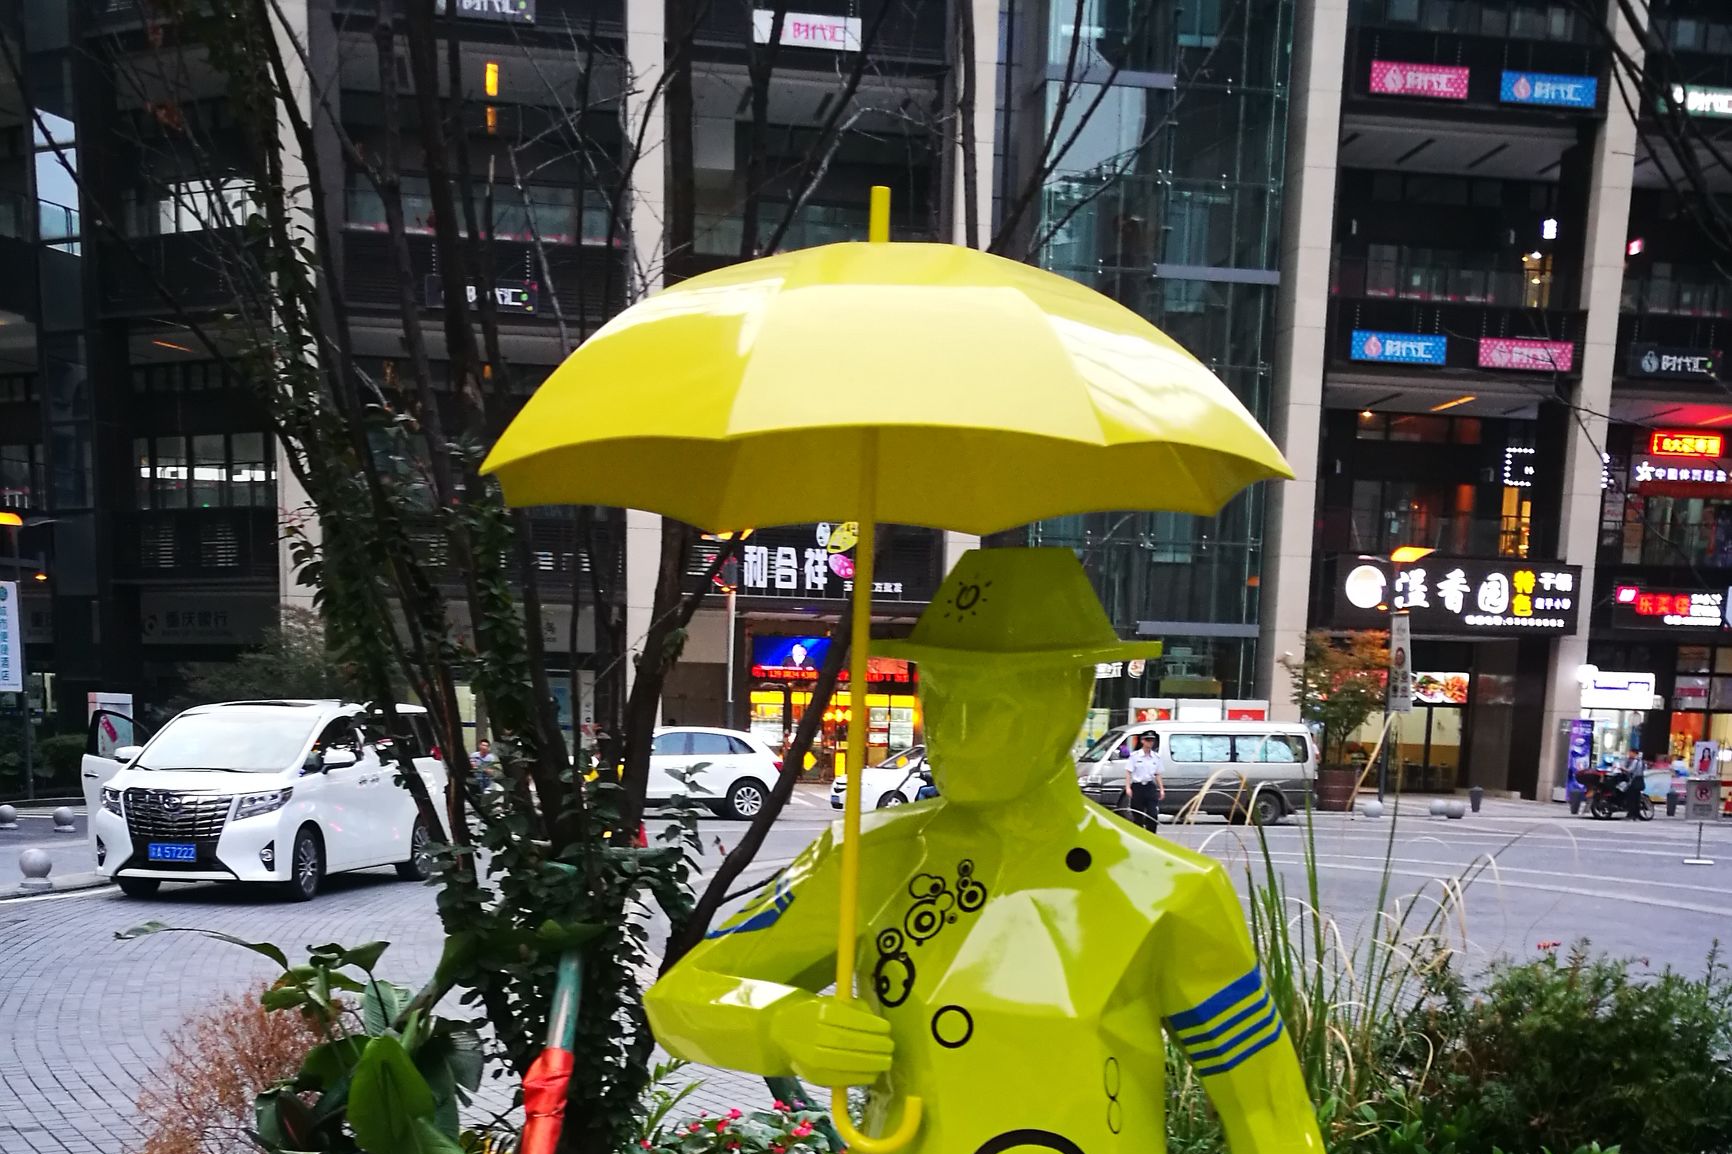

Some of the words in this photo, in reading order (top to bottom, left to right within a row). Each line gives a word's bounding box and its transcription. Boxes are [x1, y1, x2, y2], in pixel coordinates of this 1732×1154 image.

[793, 22, 846, 42] 时代汇
[1406, 71, 1457, 91] 时代汇
[1534, 81, 1584, 101] 时代汇
[1384, 339, 1433, 359] 时代汇
[1661, 355, 1709, 373] 时代汇
[743, 545, 829, 591] 和合祥
